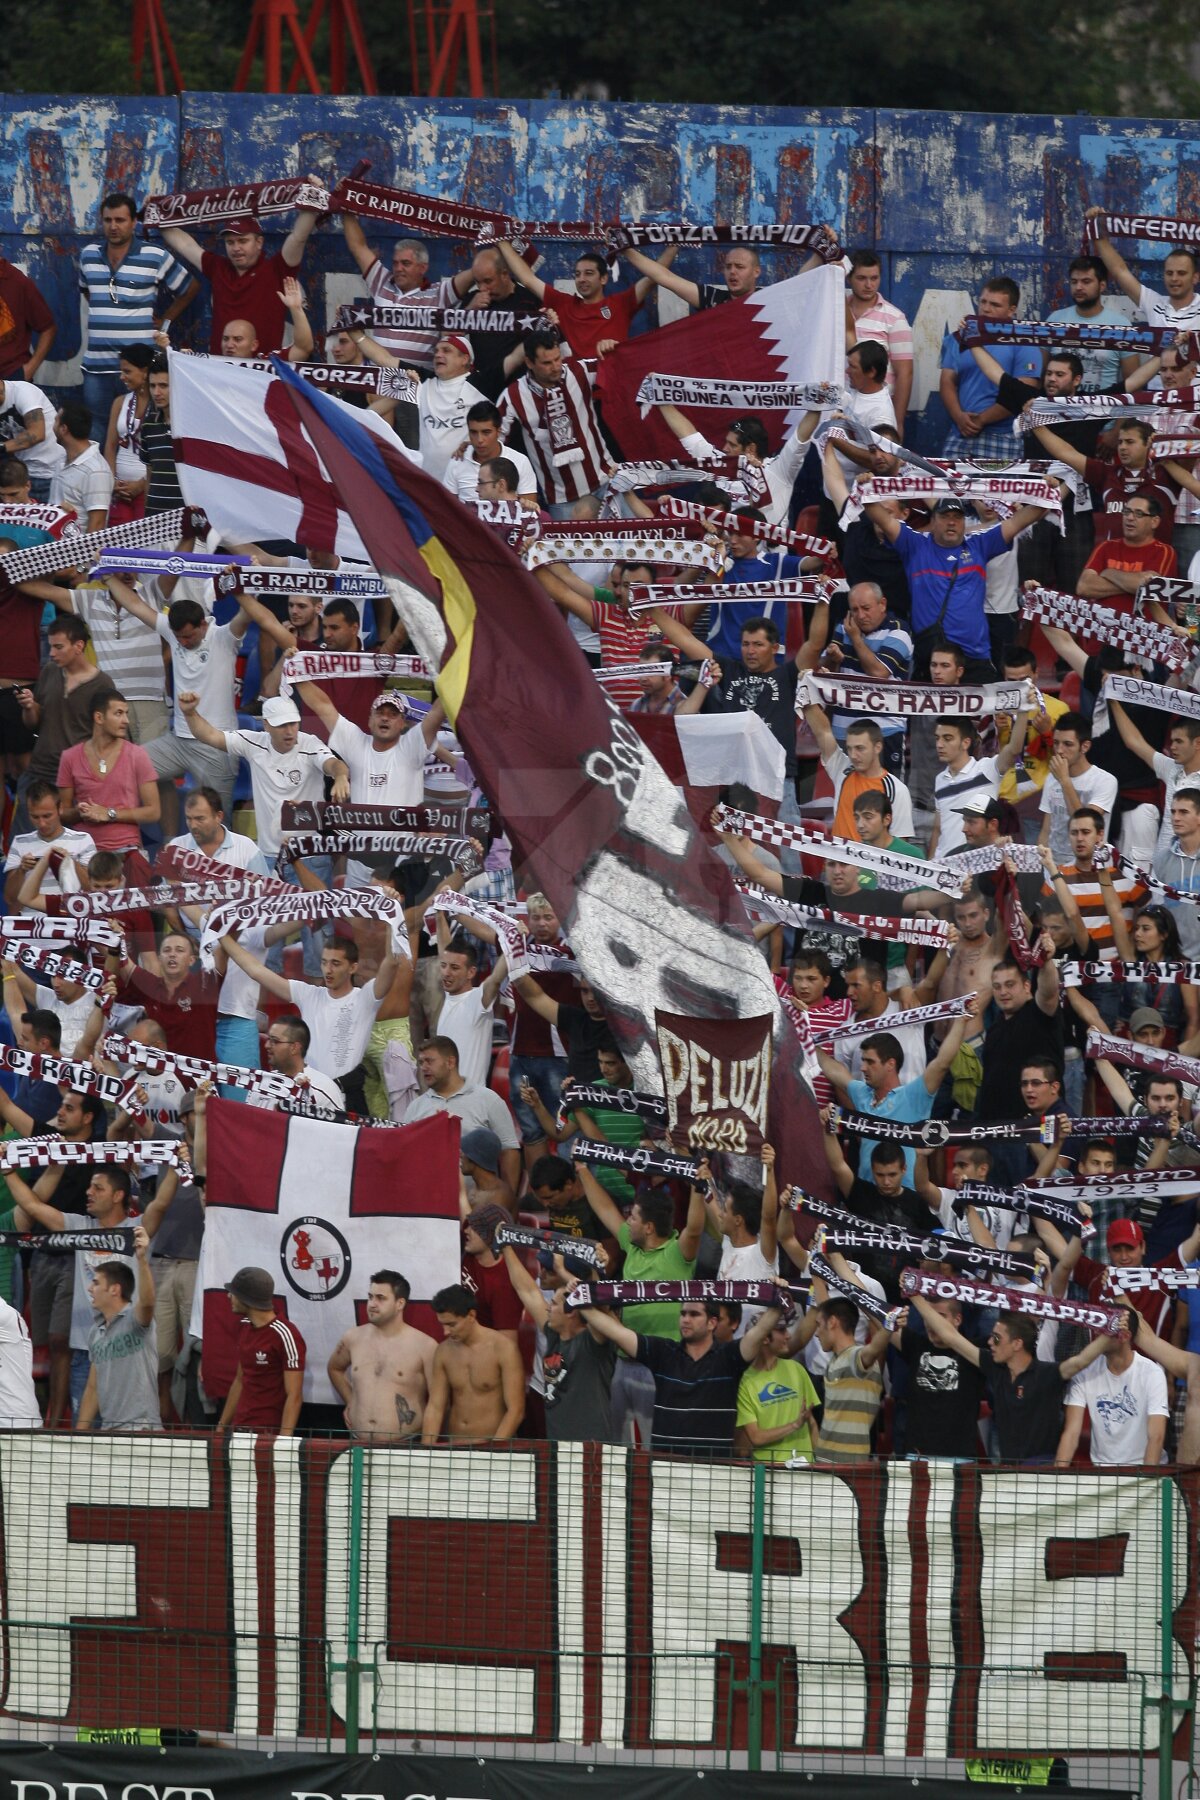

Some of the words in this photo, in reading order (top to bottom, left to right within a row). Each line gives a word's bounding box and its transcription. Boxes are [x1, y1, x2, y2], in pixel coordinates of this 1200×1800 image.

[160, 187, 254, 221] Rapidist
[346, 189, 368, 207] FC
[368, 196, 415, 217] RAPID
[630, 224, 718, 244] FORZA
[731, 224, 811, 244] RAPID
[373, 307, 437, 328] LEGIONE
[443, 308, 515, 332] GRANATA
[1087, 323, 1138, 332] PARK
[984, 322, 1068, 337] WEST
[1079, 327, 1154, 343] HAM
[997, 335, 1105, 348] united
[299, 366, 376, 386] FORZA
[654, 377, 685, 388] 100
[692, 381, 709, 390] %
[872, 476, 935, 494] RAPID
[1, 505, 59, 523] RAPID
[239, 573, 264, 586] FC
[269, 575, 328, 590] RAPID
[711, 579, 803, 599] RAPID
[303, 655, 361, 674] RAPID
[819, 687, 890, 712] U.F.C.
[898, 694, 983, 713] RAPID
[287, 836, 308, 857] FC
[311, 835, 366, 854] RAPID
[846, 845, 875, 863] F.C.
[879, 855, 934, 878] RAPID
[221, 896, 312, 926] FORZA
[319, 892, 395, 914] RAPID
[41, 1058, 124, 1098] RAPID
[656, 1025, 772, 1139] PELUZA
[687, 1113, 749, 1152] NORD
[969, 1123, 1022, 1140] STIL
[1037, 1176, 1076, 1188] FC
[1086, 1169, 1197, 1186] RAPID
[1072, 1183, 1160, 1198] 1923
[48, 1233, 126, 1251] INFIERNO
[969, 1246, 1017, 1272] STIL
[919, 1275, 1010, 1309] FORZA
[1018, 1297, 1108, 1328] RAPID
